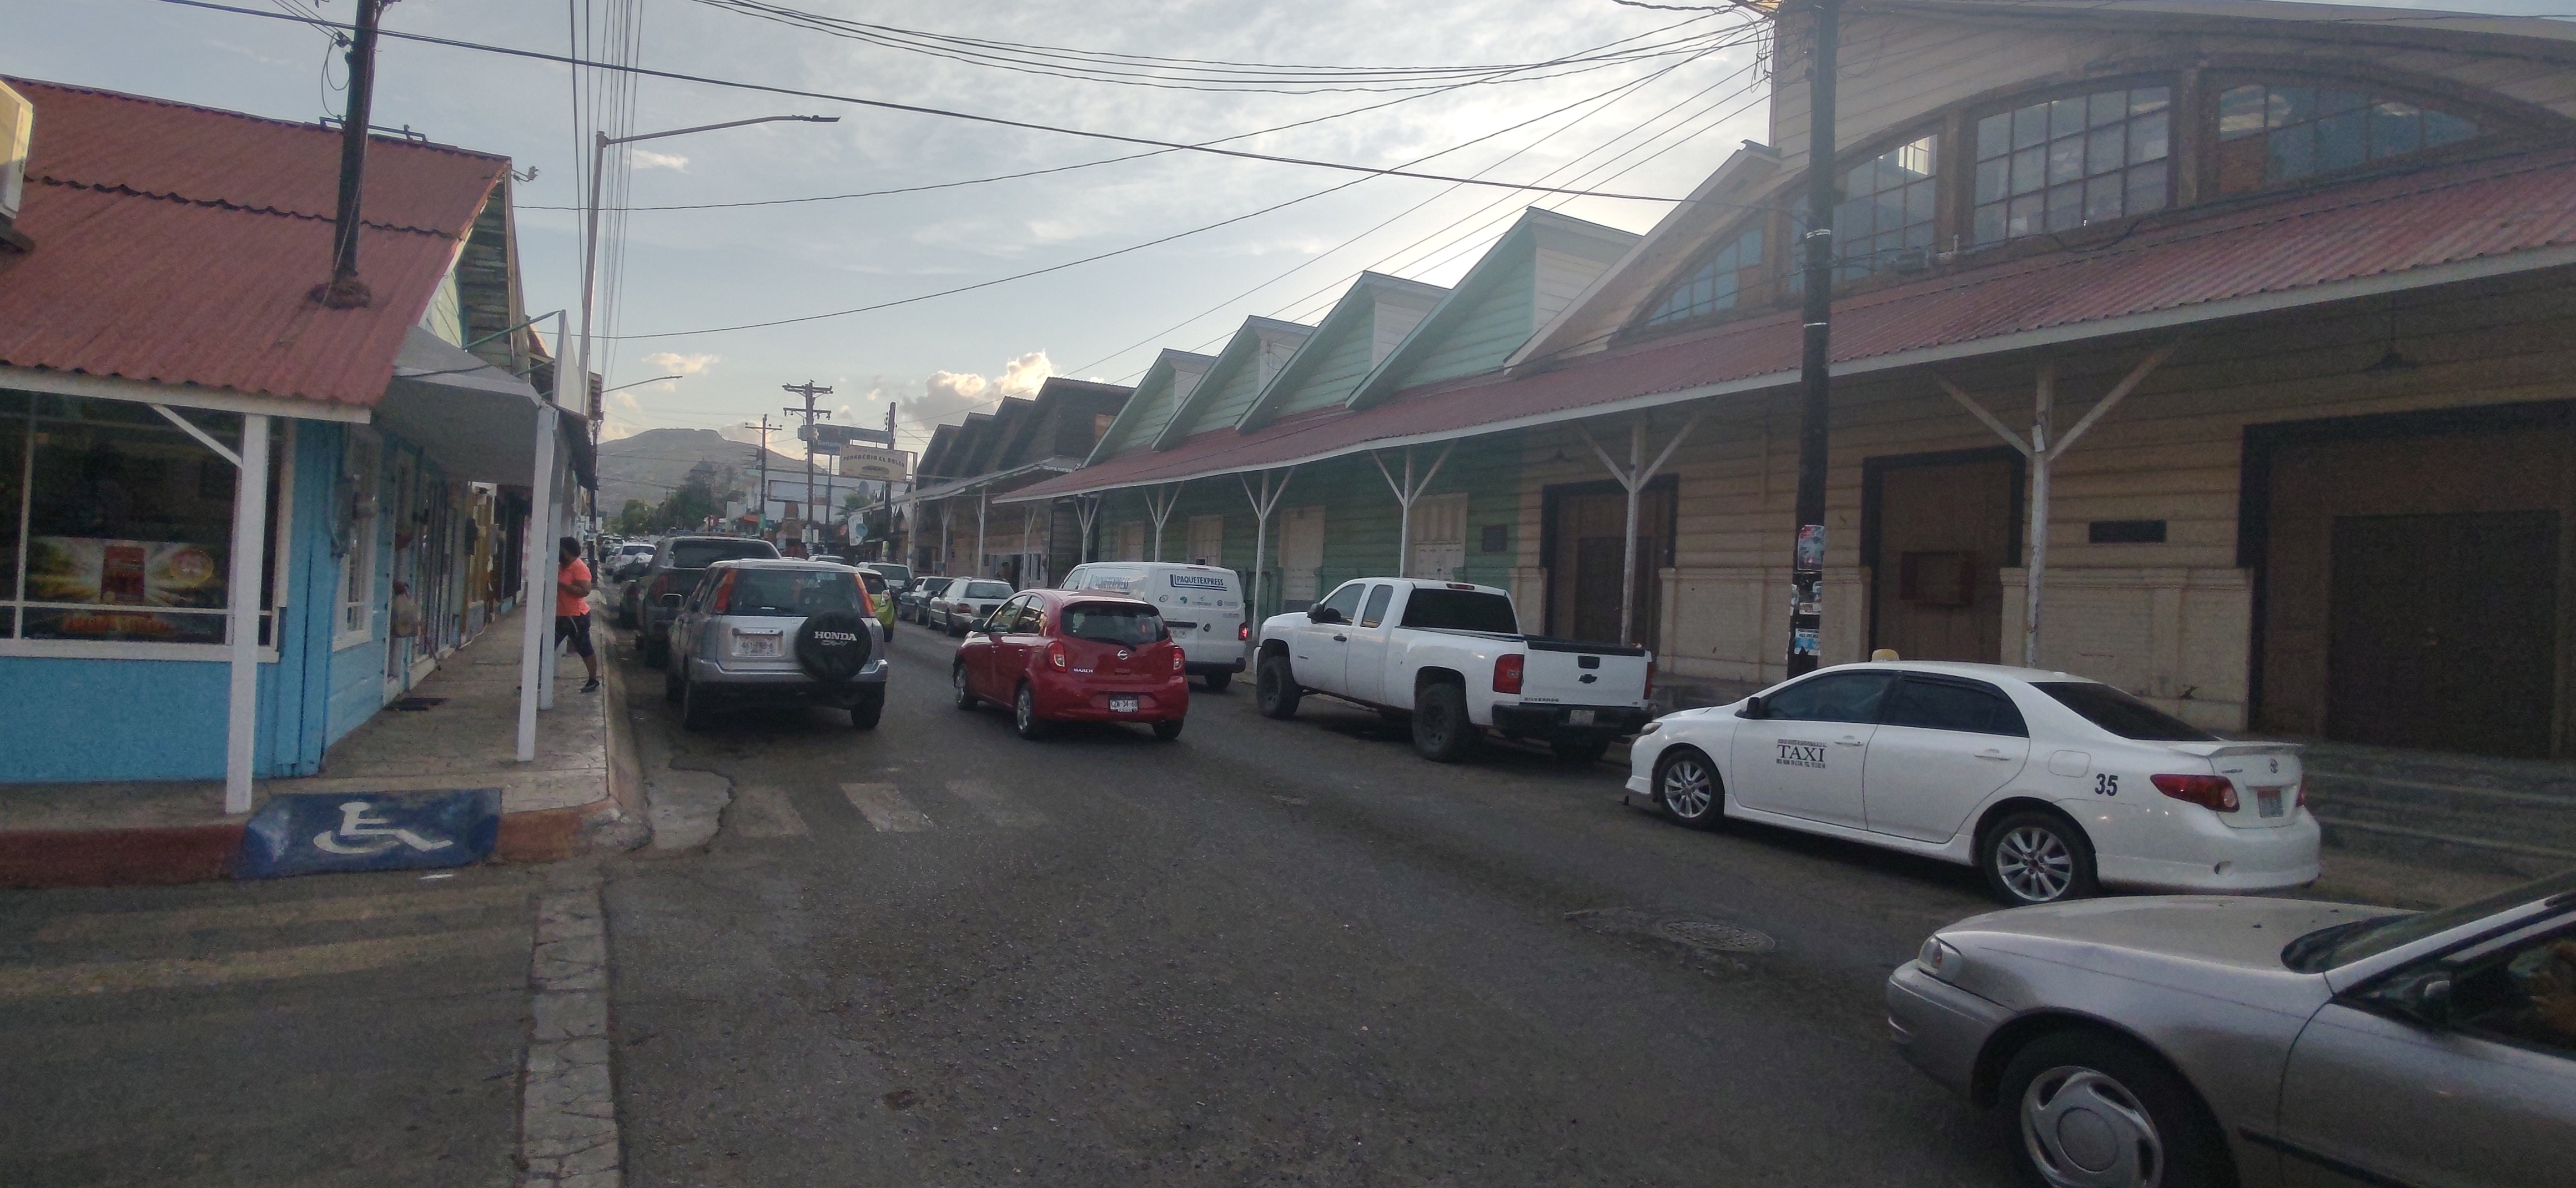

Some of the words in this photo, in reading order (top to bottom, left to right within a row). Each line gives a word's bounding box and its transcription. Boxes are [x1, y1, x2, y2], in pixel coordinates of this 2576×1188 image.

[1176, 576, 1224, 586] PAQUETEXPRESS
[814, 631, 857, 641] HONDA
[1776, 744, 1825, 762] TAXI
[2094, 773, 2119, 797] 35
